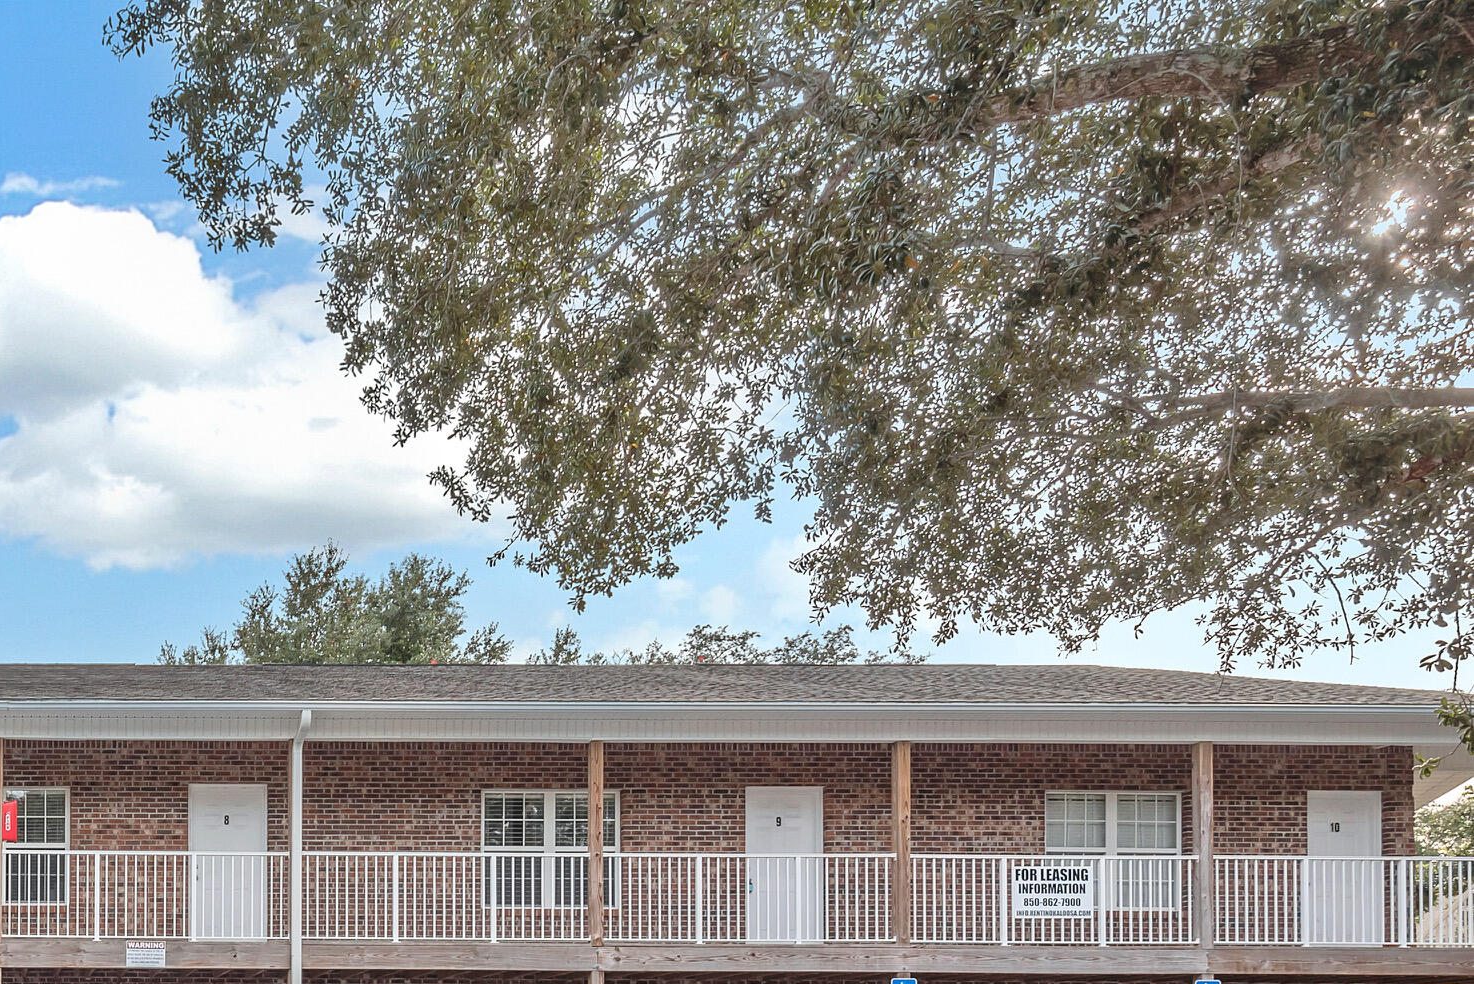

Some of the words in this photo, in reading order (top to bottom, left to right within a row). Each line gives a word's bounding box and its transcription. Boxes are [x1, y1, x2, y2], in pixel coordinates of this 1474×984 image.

[224, 815, 230, 825] 8
[776, 816, 782, 827] 9
[1330, 822, 1340, 832] 10
[1015, 868, 1037, 881] FOR
[1040, 868, 1089, 881] LEASING
[1018, 883, 1086, 894] INFORMATION
[1023, 897, 1081, 907] 850-862-7900
